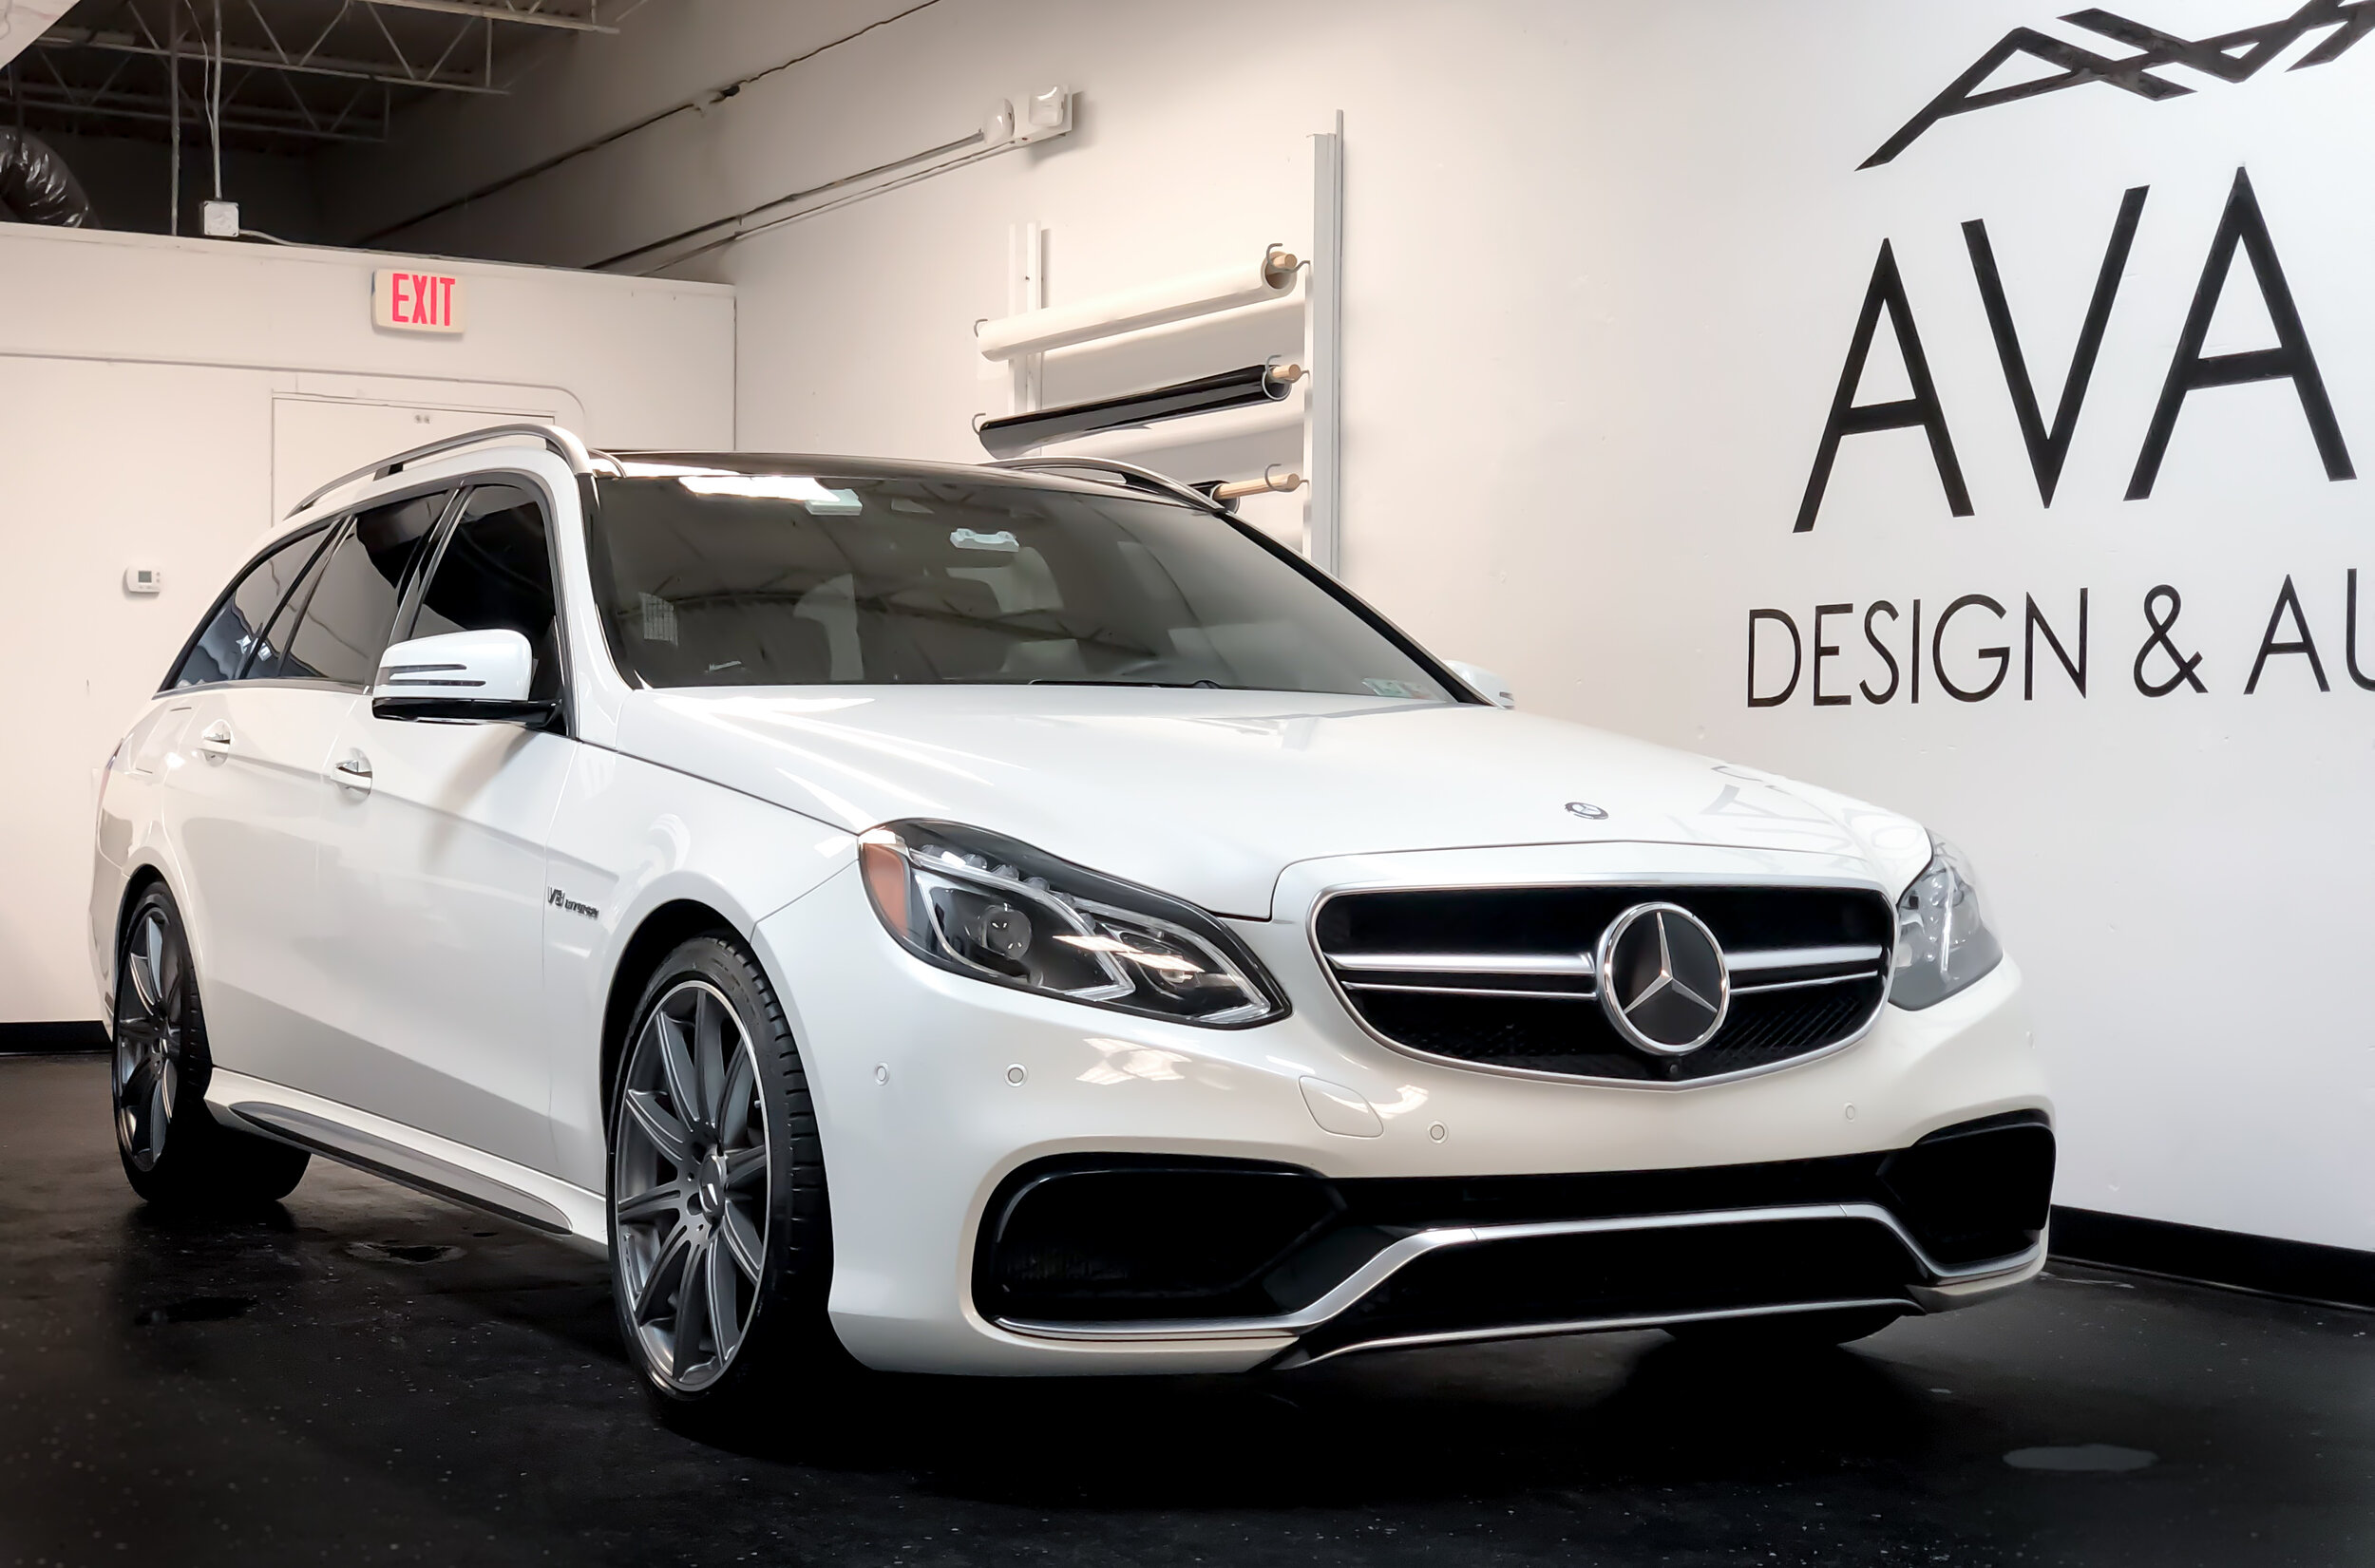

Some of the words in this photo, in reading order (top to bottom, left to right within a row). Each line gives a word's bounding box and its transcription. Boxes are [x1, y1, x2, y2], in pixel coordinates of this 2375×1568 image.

[392, 273, 456, 327] EXIT
[1748, 587, 2088, 708] DESIGN
[2134, 584, 2209, 698] &
